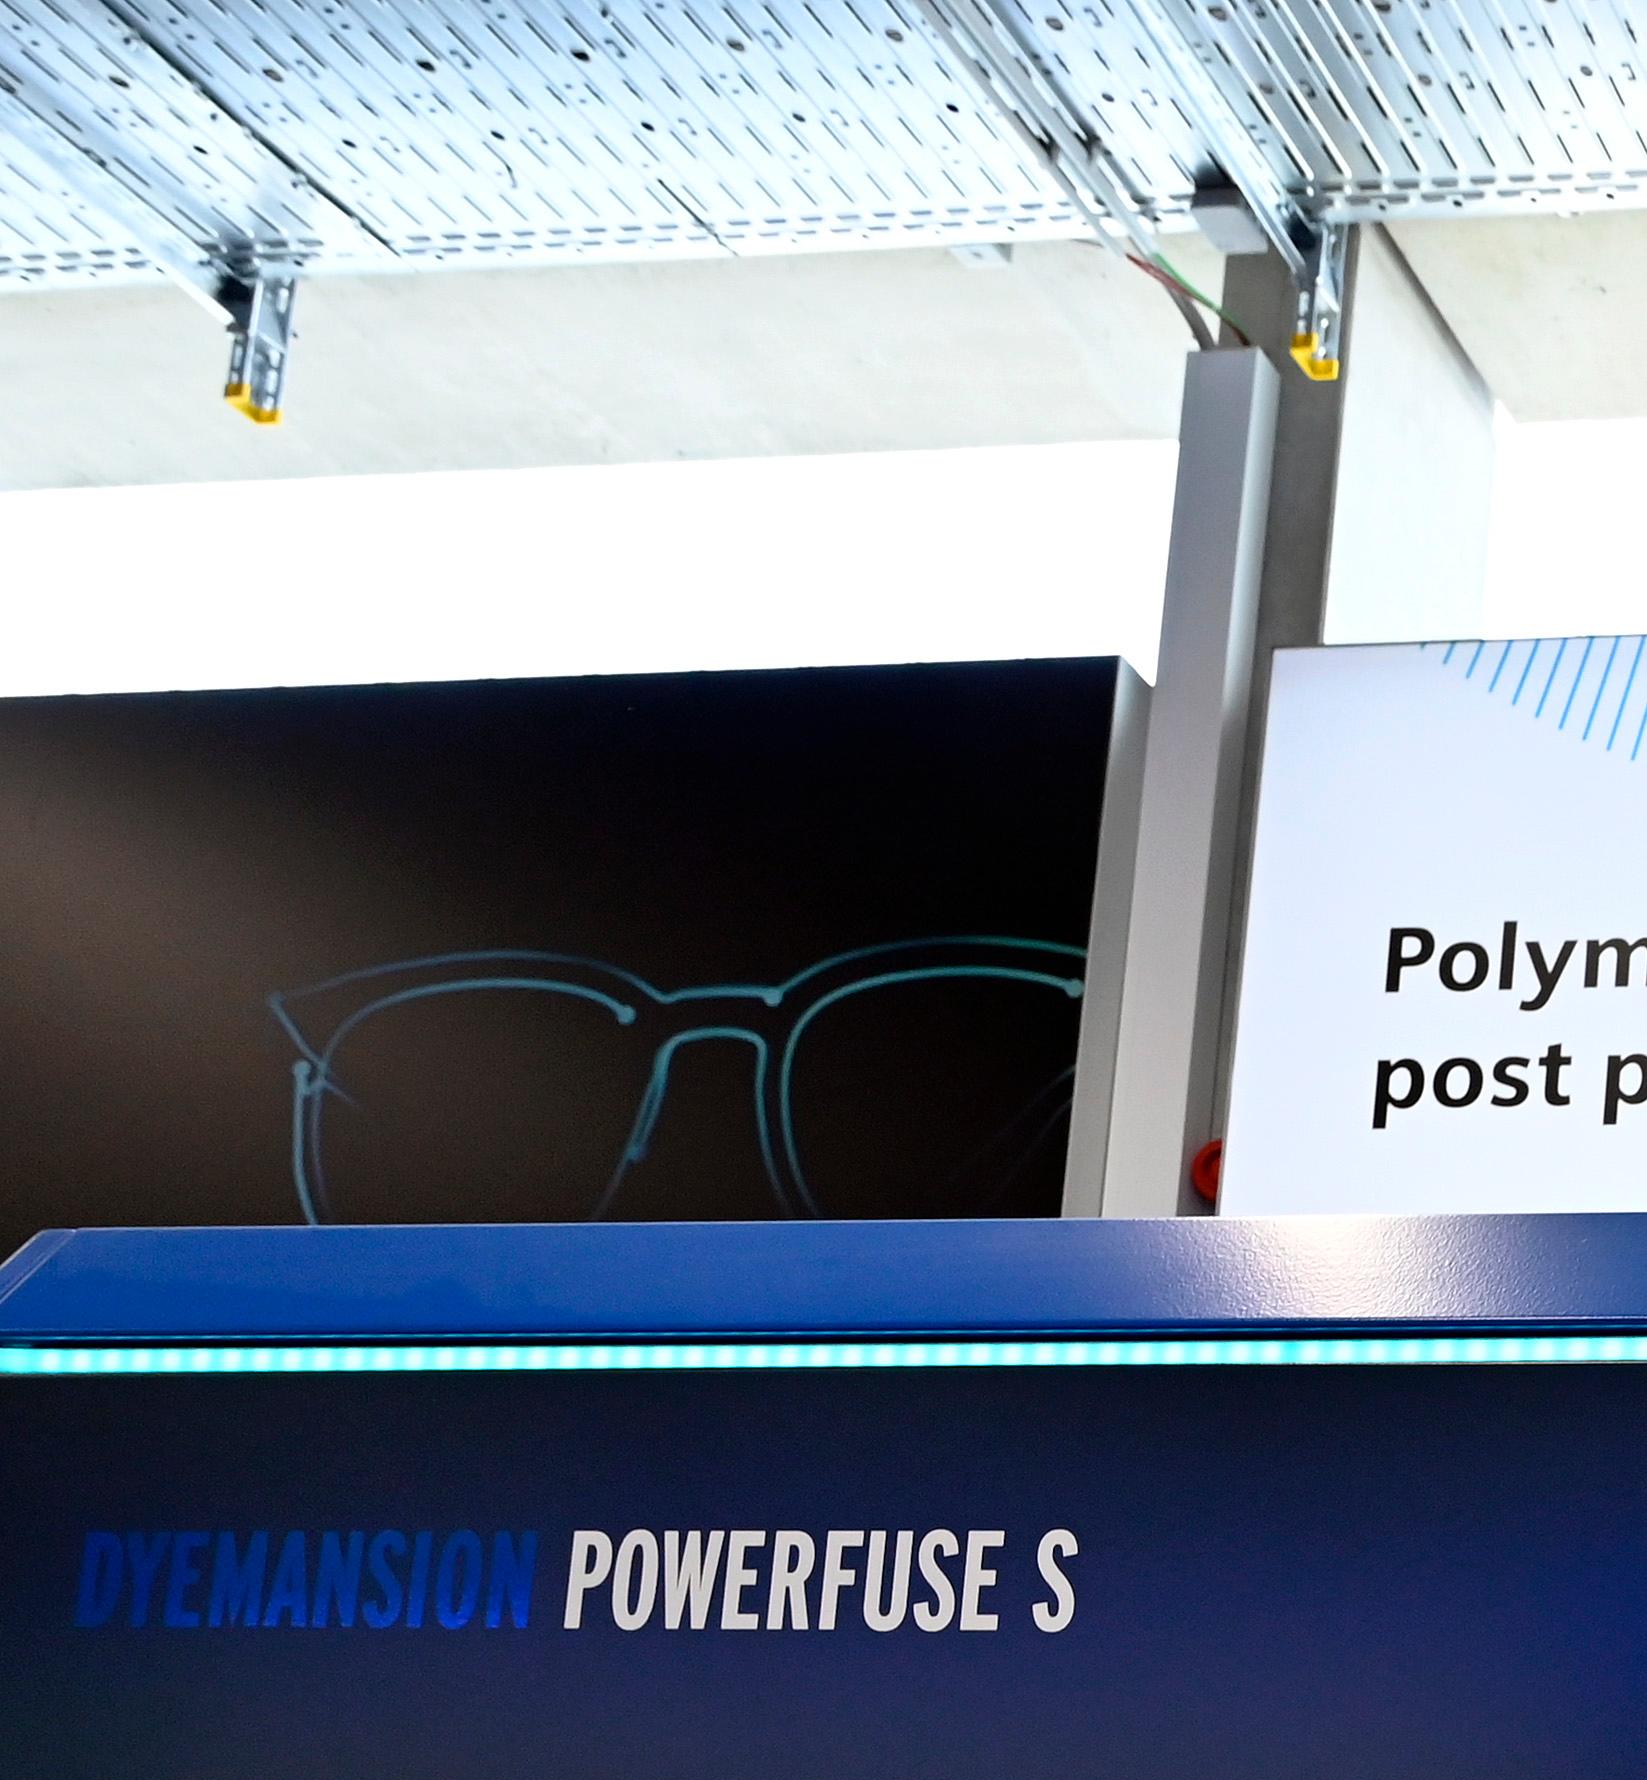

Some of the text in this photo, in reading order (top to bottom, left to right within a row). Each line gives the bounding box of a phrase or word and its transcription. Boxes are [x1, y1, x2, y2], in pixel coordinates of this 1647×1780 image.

[1372, 1042, 1572, 1130] post
[73, 1528, 1079, 1633] DYEMANSION POWERFUSE S
